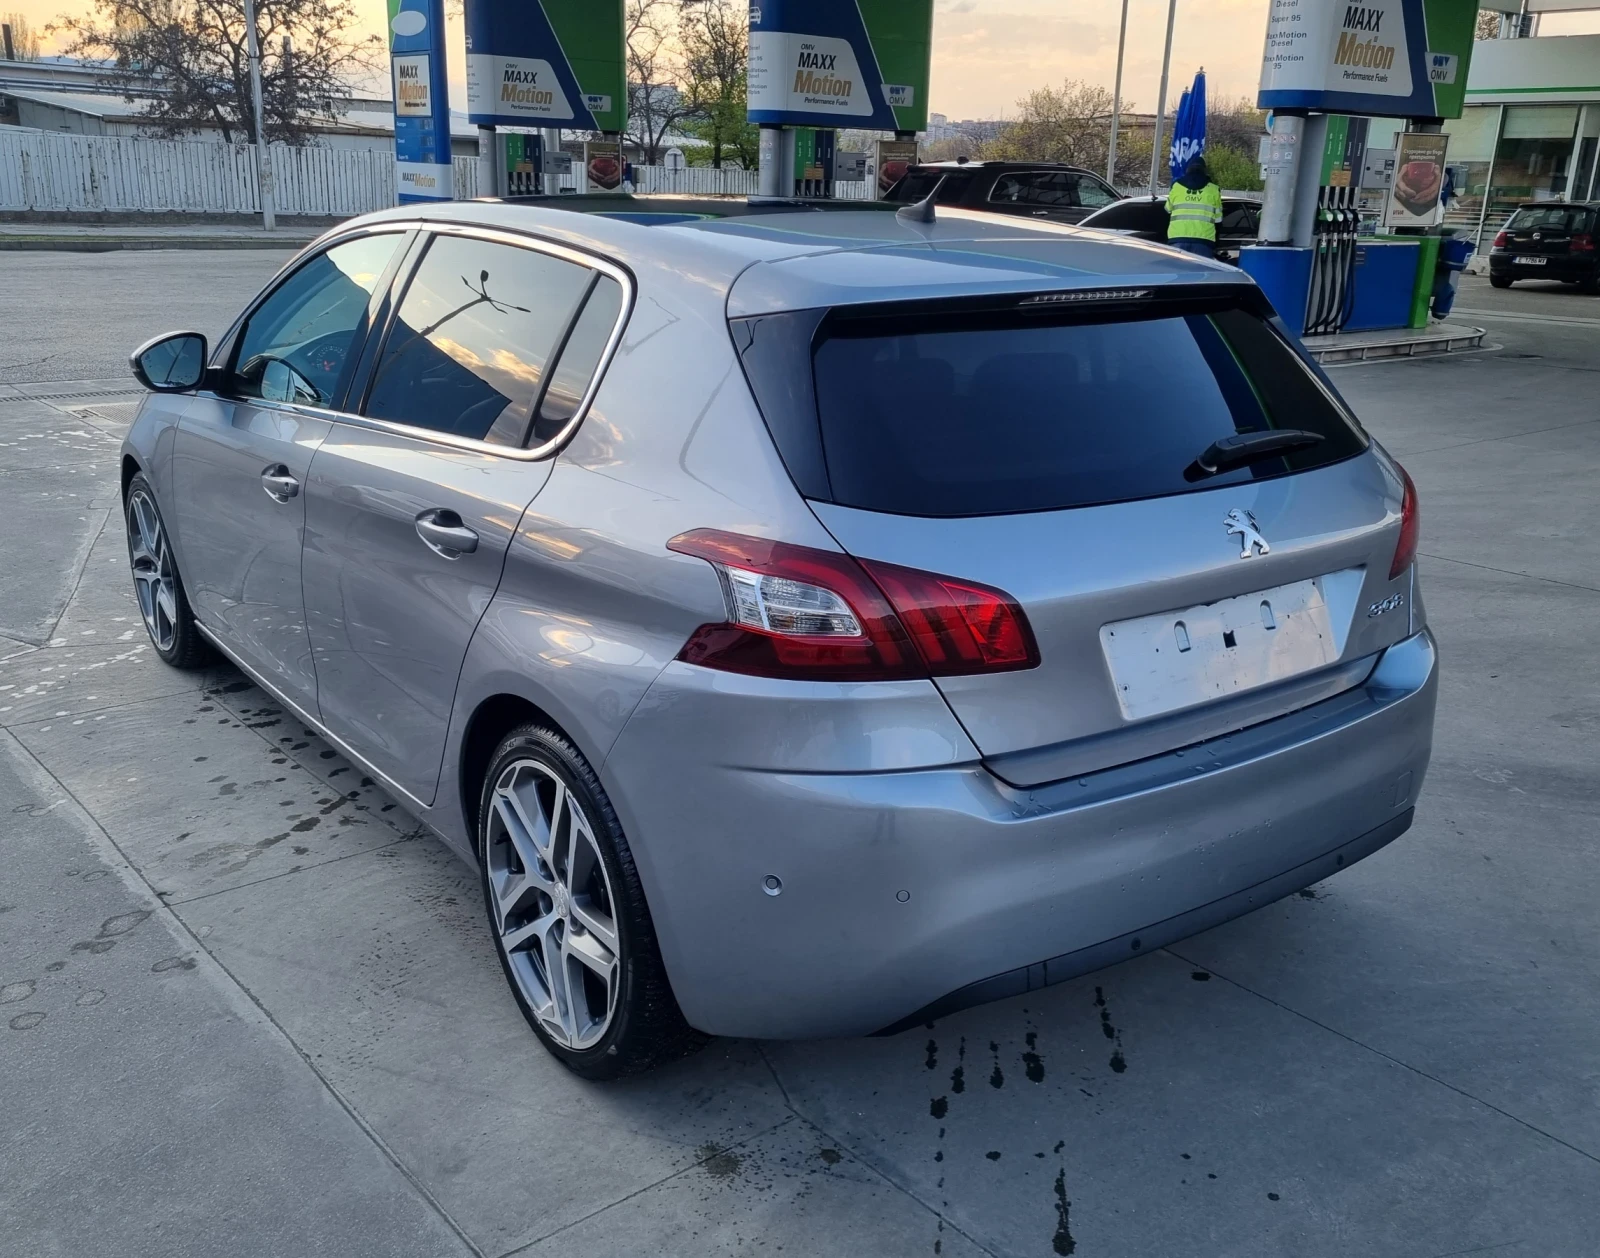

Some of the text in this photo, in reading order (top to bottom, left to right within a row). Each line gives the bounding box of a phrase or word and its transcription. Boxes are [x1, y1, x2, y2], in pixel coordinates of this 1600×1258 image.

[1271, 14, 1301, 23] Super 95
[1343, 5, 1384, 32] MAXX
[801, 43, 815, 51] OMV
[1271, 39, 1293, 47] Diesel
[1334, 31, 1395, 70] Motion
[797, 52, 836, 70] MAXX
[1272, 62, 1282, 70] 95
[400, 65, 418, 79] MAXX
[503, 70, 538, 84] MAXX
[1343, 70, 1388, 83] Performance Fuels
[1430, 69, 1448, 81] OMV
[399, 80, 427, 100] Motion
[793, 70, 852, 97] Motion
[501, 84, 553, 104] Motion
[804, 96, 848, 106] Performance Fuels
[889, 96, 906, 105] OMV
[1367, 592, 1404, 618] 308
